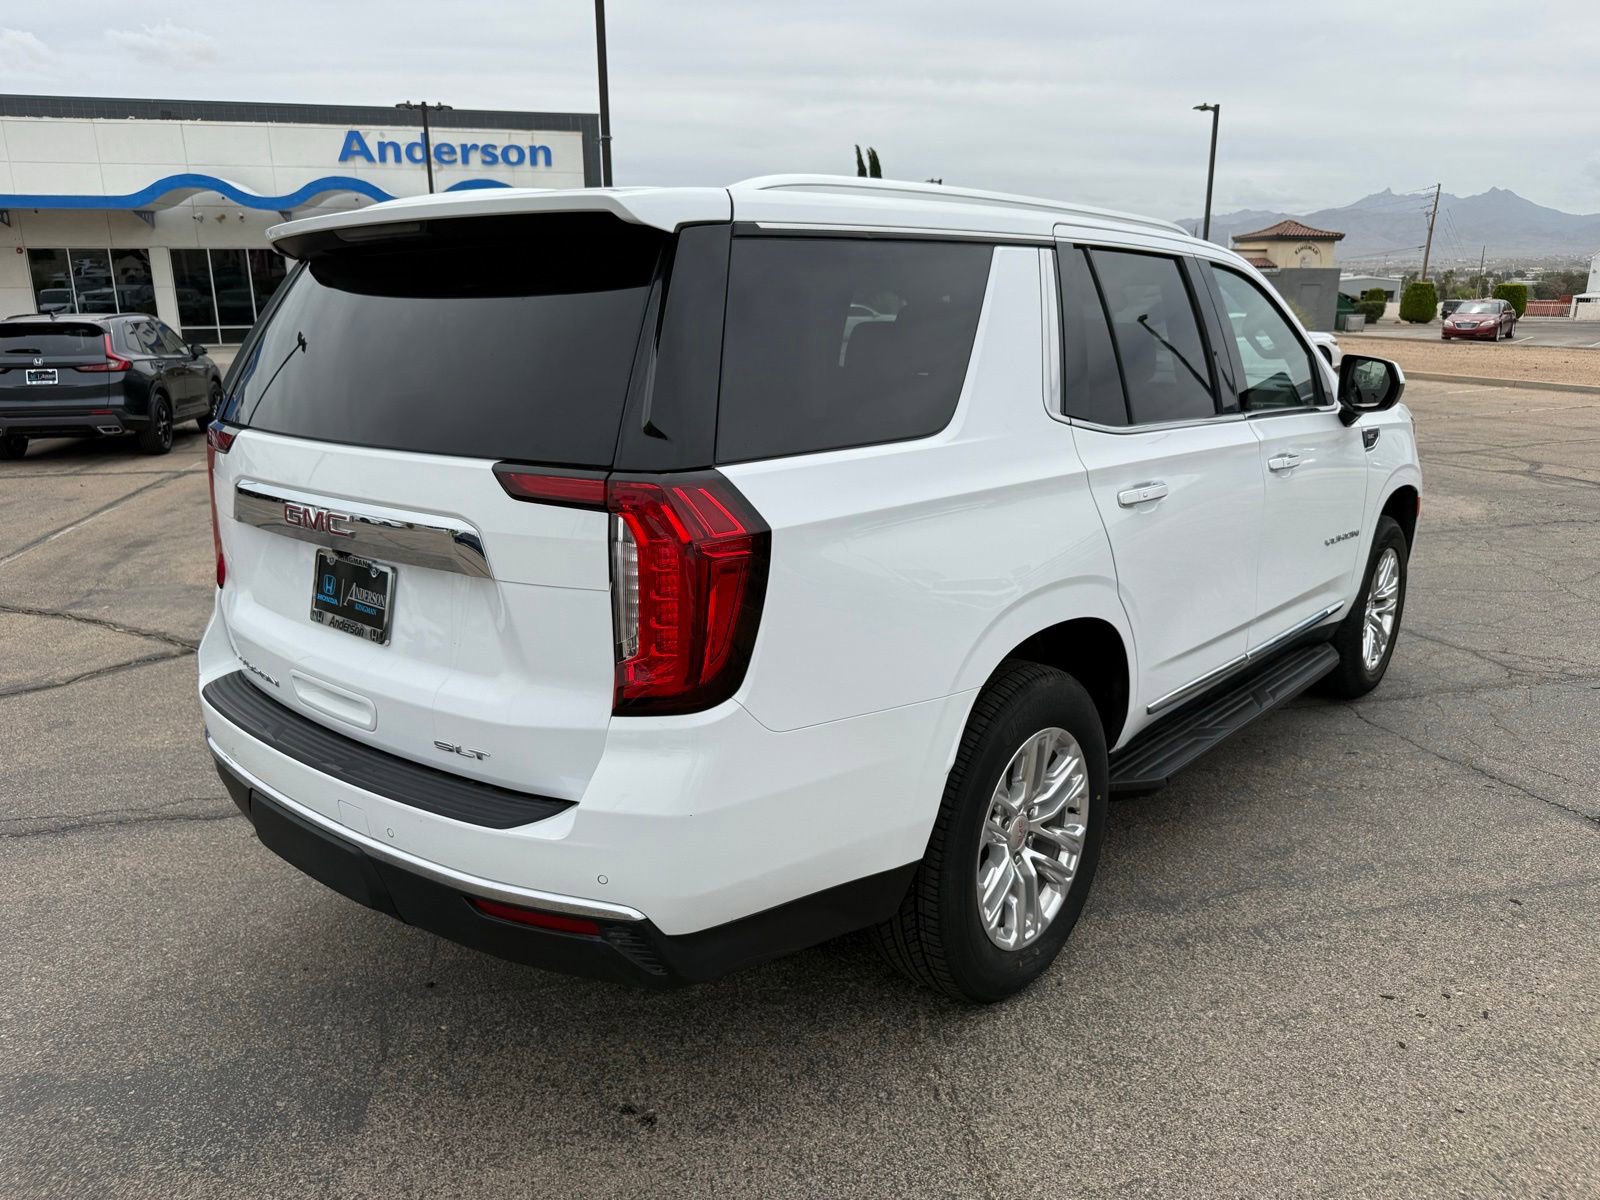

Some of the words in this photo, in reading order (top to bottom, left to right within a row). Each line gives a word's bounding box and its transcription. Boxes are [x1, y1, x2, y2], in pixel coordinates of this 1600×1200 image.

[338, 130, 553, 167] Anderson
[284, 503, 353, 537] GMC
[329, 616, 365, 637] Anderson
[433, 739, 491, 760] SLT
